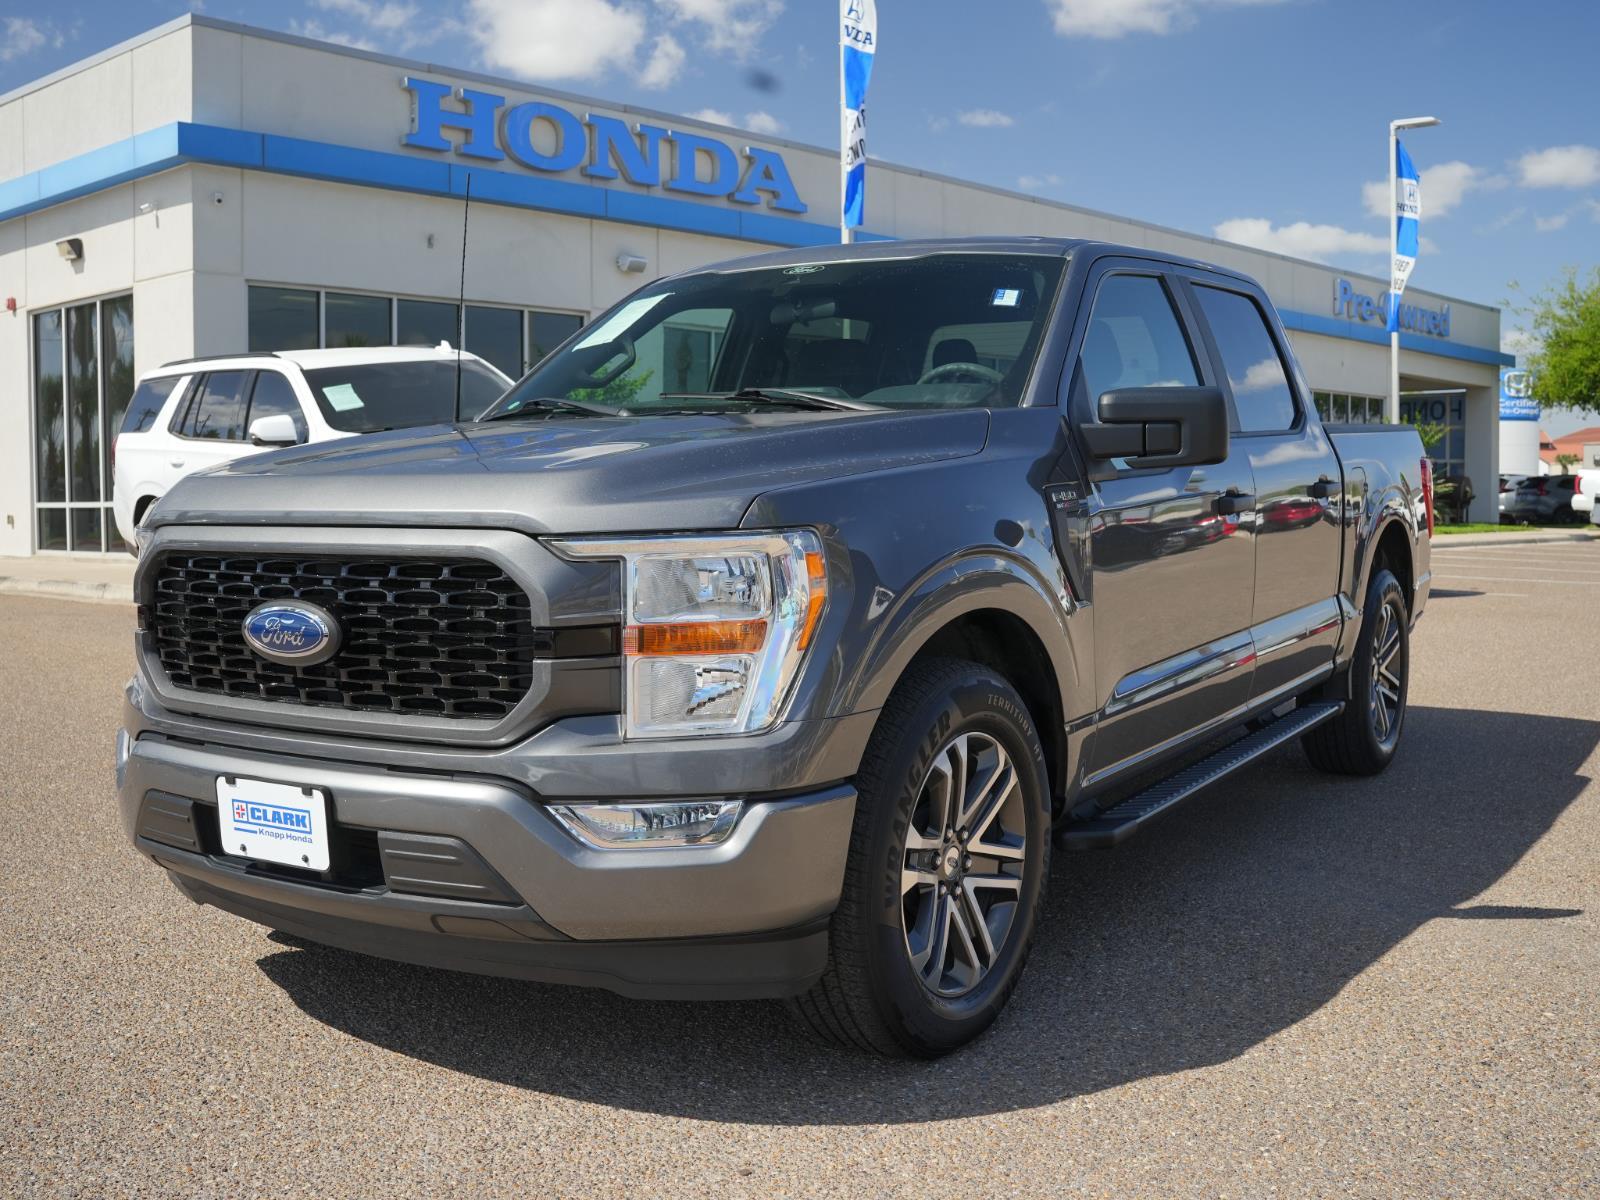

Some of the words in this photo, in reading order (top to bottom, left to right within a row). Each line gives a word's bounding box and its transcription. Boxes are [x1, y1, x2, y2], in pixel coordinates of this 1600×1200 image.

[401, 76, 808, 213] HONDA
[261, 616, 305, 646] Ford
[988, 694, 1033, 737] TERRITORY
[250, 806, 307, 829] CLARK
[884, 709, 951, 908] WRANGLER
[258, 828, 285, 840] Knapp
[286, 833, 313, 844] Honda
